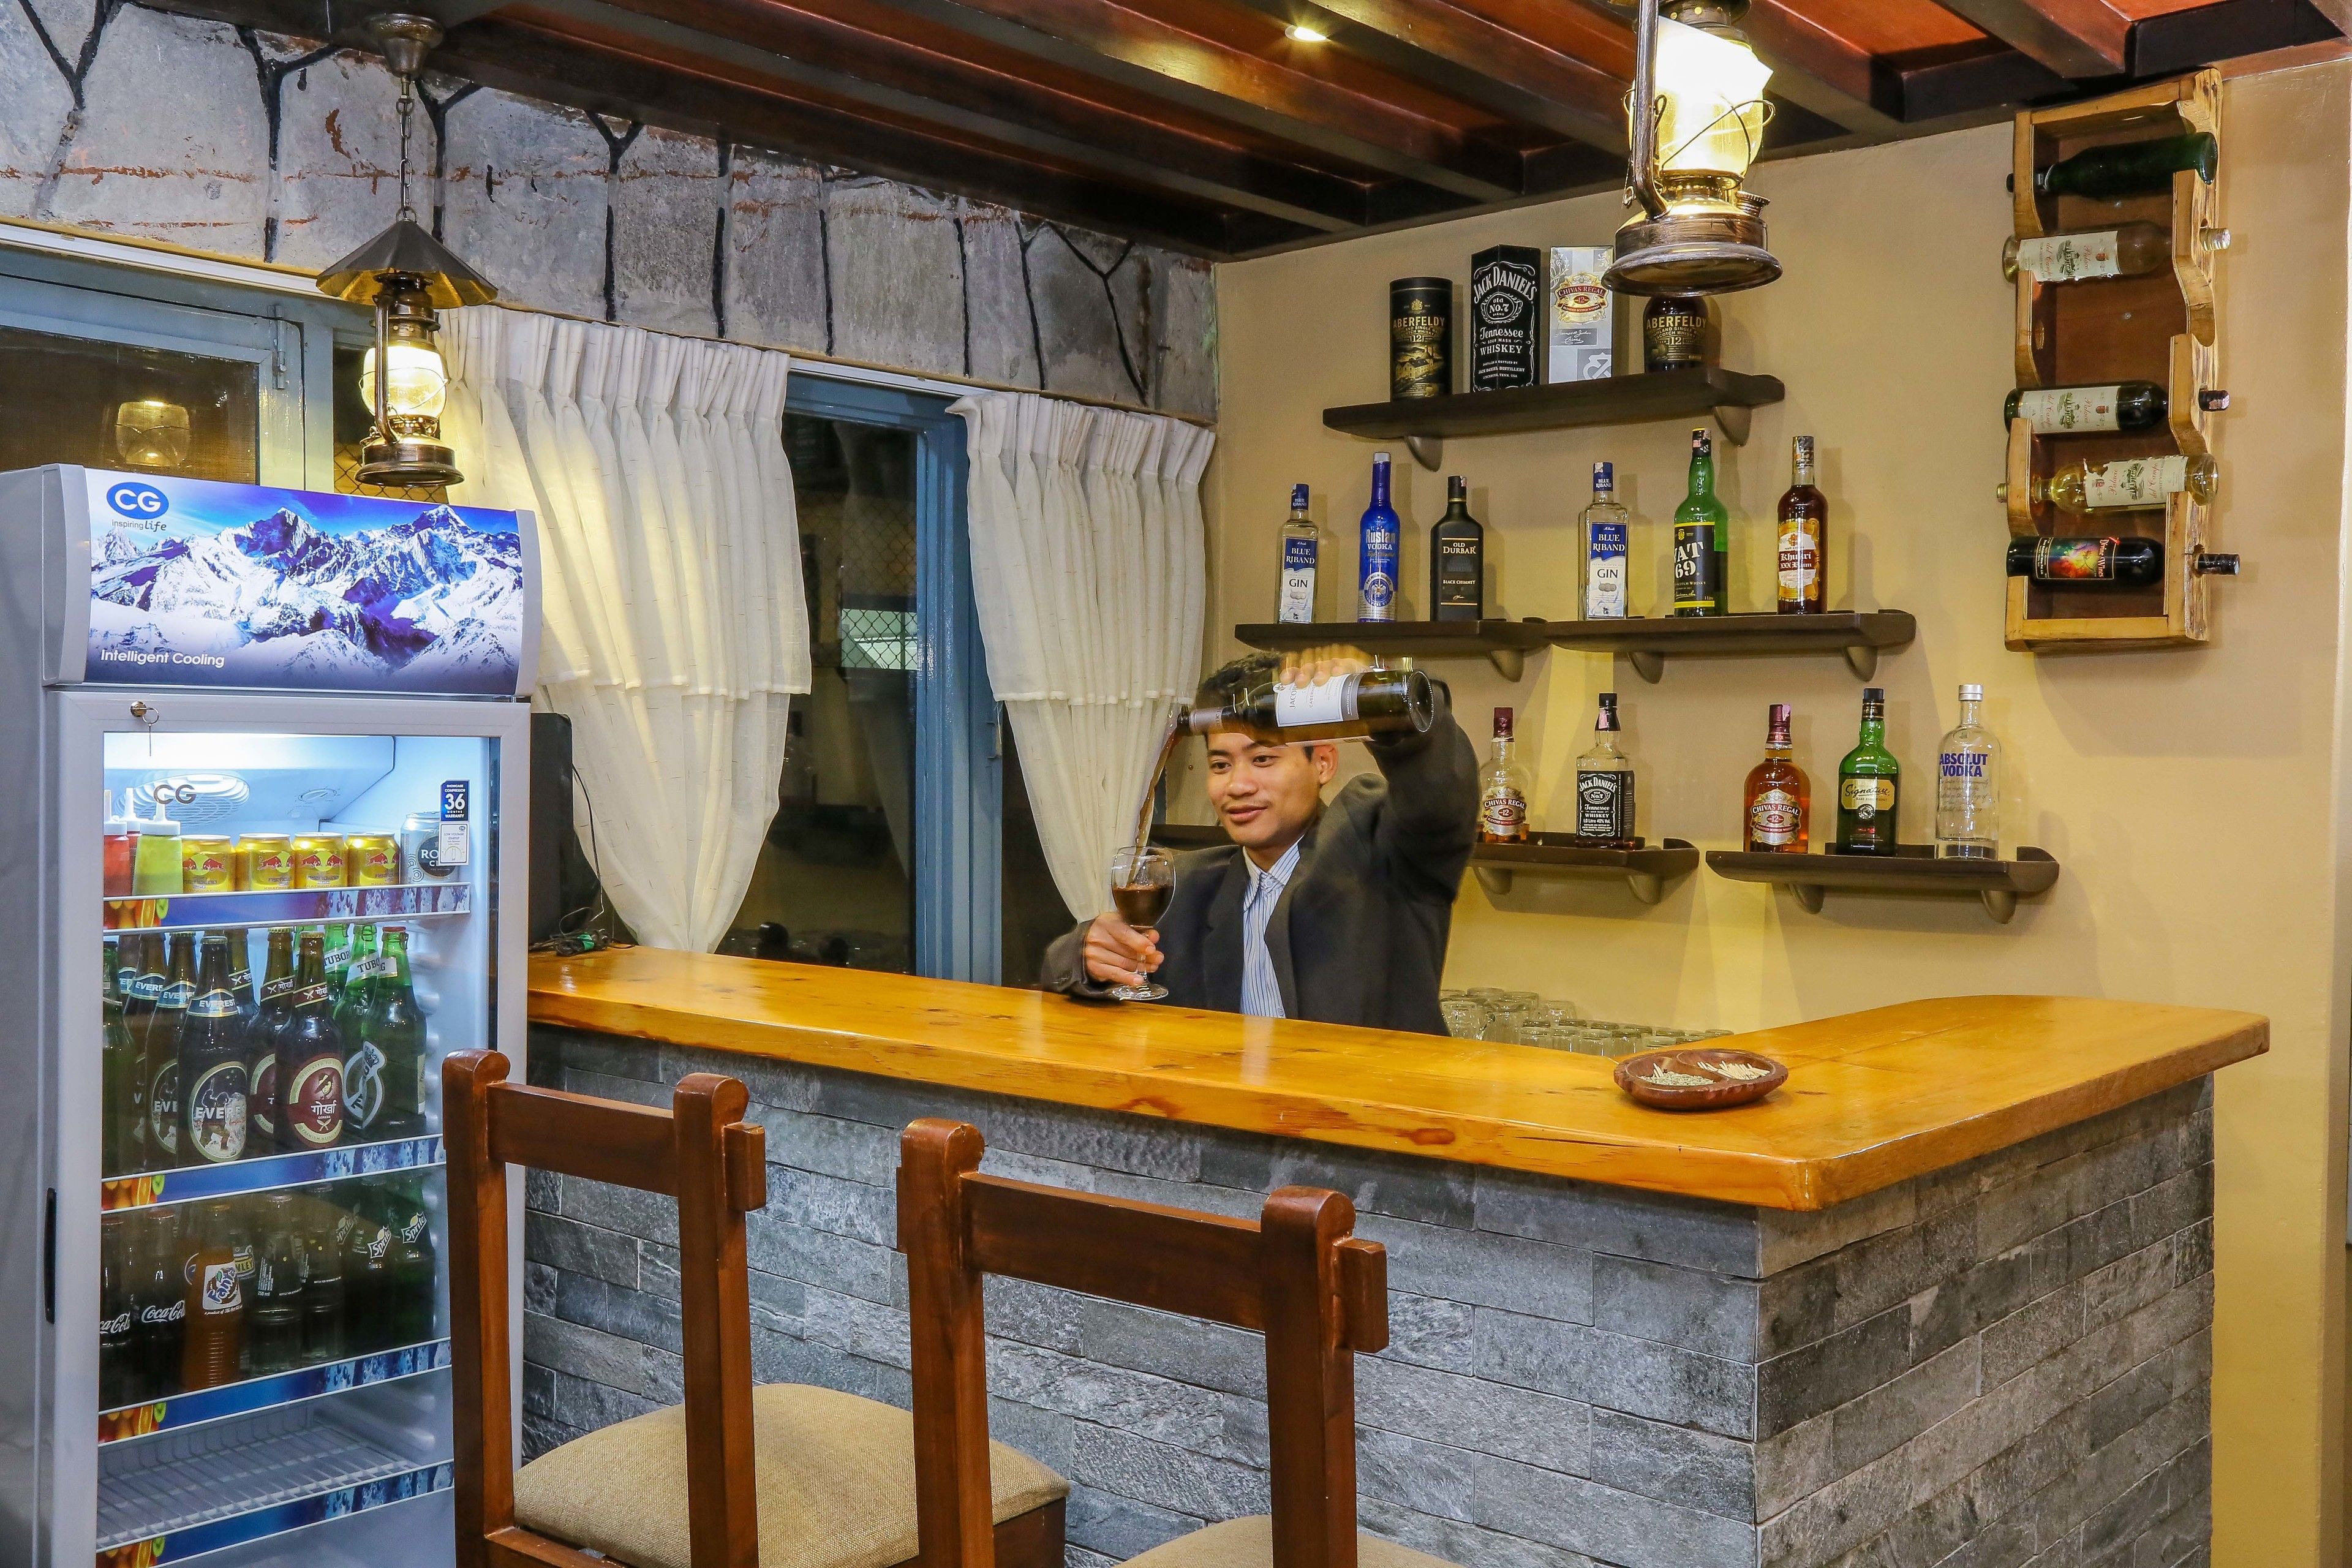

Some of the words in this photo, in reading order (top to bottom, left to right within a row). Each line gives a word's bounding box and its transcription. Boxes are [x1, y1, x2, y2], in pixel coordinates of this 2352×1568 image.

[1474, 274, 1492, 304] JACK
[1493, 266, 1537, 300] DANIEL'S
[1558, 287, 1581, 296] CHIVAS
[1583, 287, 1605, 295] REGAL
[1393, 316, 1445, 328] ABERFELDY
[1646, 316, 1706, 330] ABERFELDY
[1480, 327, 1523, 339] Tennessee
[1480, 344, 1523, 356] WHISKEY
[115, 489, 161, 513] CG
[111, 519, 144, 530] inspiring
[145, 520, 167, 532] life
[1366, 529, 1396, 544] Ruslan
[1598, 533, 1620, 542] BLUE
[1443, 546, 1476, 554] DURBAR
[1593, 543, 1625, 552] RIBAND
[2098, 539, 2109, 556] Divine
[1286, 555, 1315, 564] RIBAND
[1780, 552, 1812, 562] Khuri
[1597, 568, 1618, 579] GIN
[1675, 560, 1697, 579] 69
[2097, 556, 2106, 578] Wines
[1289, 578, 1308, 587] GIN
[100, 649, 169, 665] Intelligent
[172, 652, 225, 668] Cooling
[1939, 753, 1988, 766] ABSOLUT
[1942, 765, 1983, 777] VODKA
[1580, 779, 1593, 792] JACK
[1593, 777, 1618, 792] DANIEL'S
[154, 784, 197, 804] CG
[1845, 784, 1890, 799] Signature
[445, 793, 466, 810] 36
[1484, 799, 1507, 808] CHIVAS
[1507, 799, 1525, 809] REGAL
[1752, 804, 1776, 813] CHIVAS
[1777, 804, 1799, 816] REGAL
[421, 849, 439, 859] RO
[311, 1100, 337, 1115] गोर्खा
[405, 1215, 426, 1242] Sprite
[372, 1229, 391, 1256] Sprite
[208, 1266, 236, 1304] Fanta
[141, 1299, 185, 1323] Coca-Col
